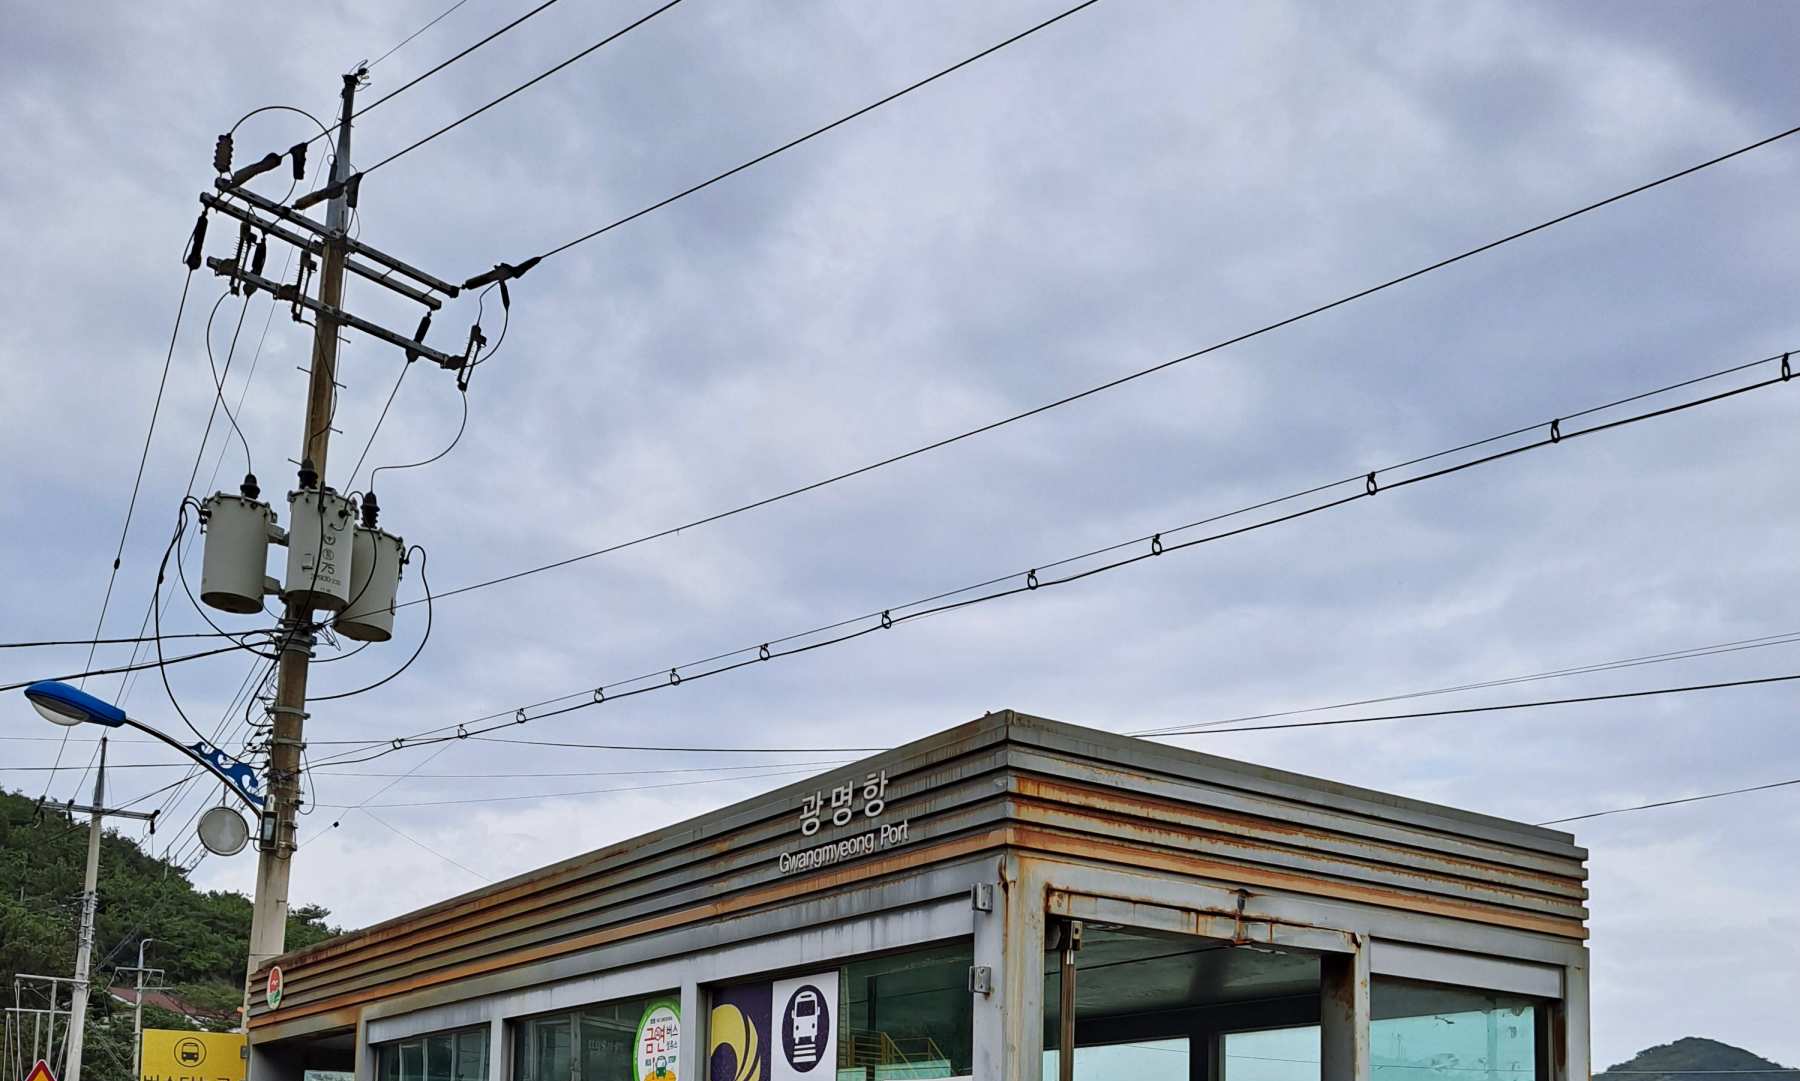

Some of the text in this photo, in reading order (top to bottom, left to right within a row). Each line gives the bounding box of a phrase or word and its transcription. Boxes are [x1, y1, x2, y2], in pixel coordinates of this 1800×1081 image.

[799, 770, 888, 835] 광명항
[779, 818, 910, 874] Gwangmyeong Port
[643, 1024, 665, 1054] 금연
